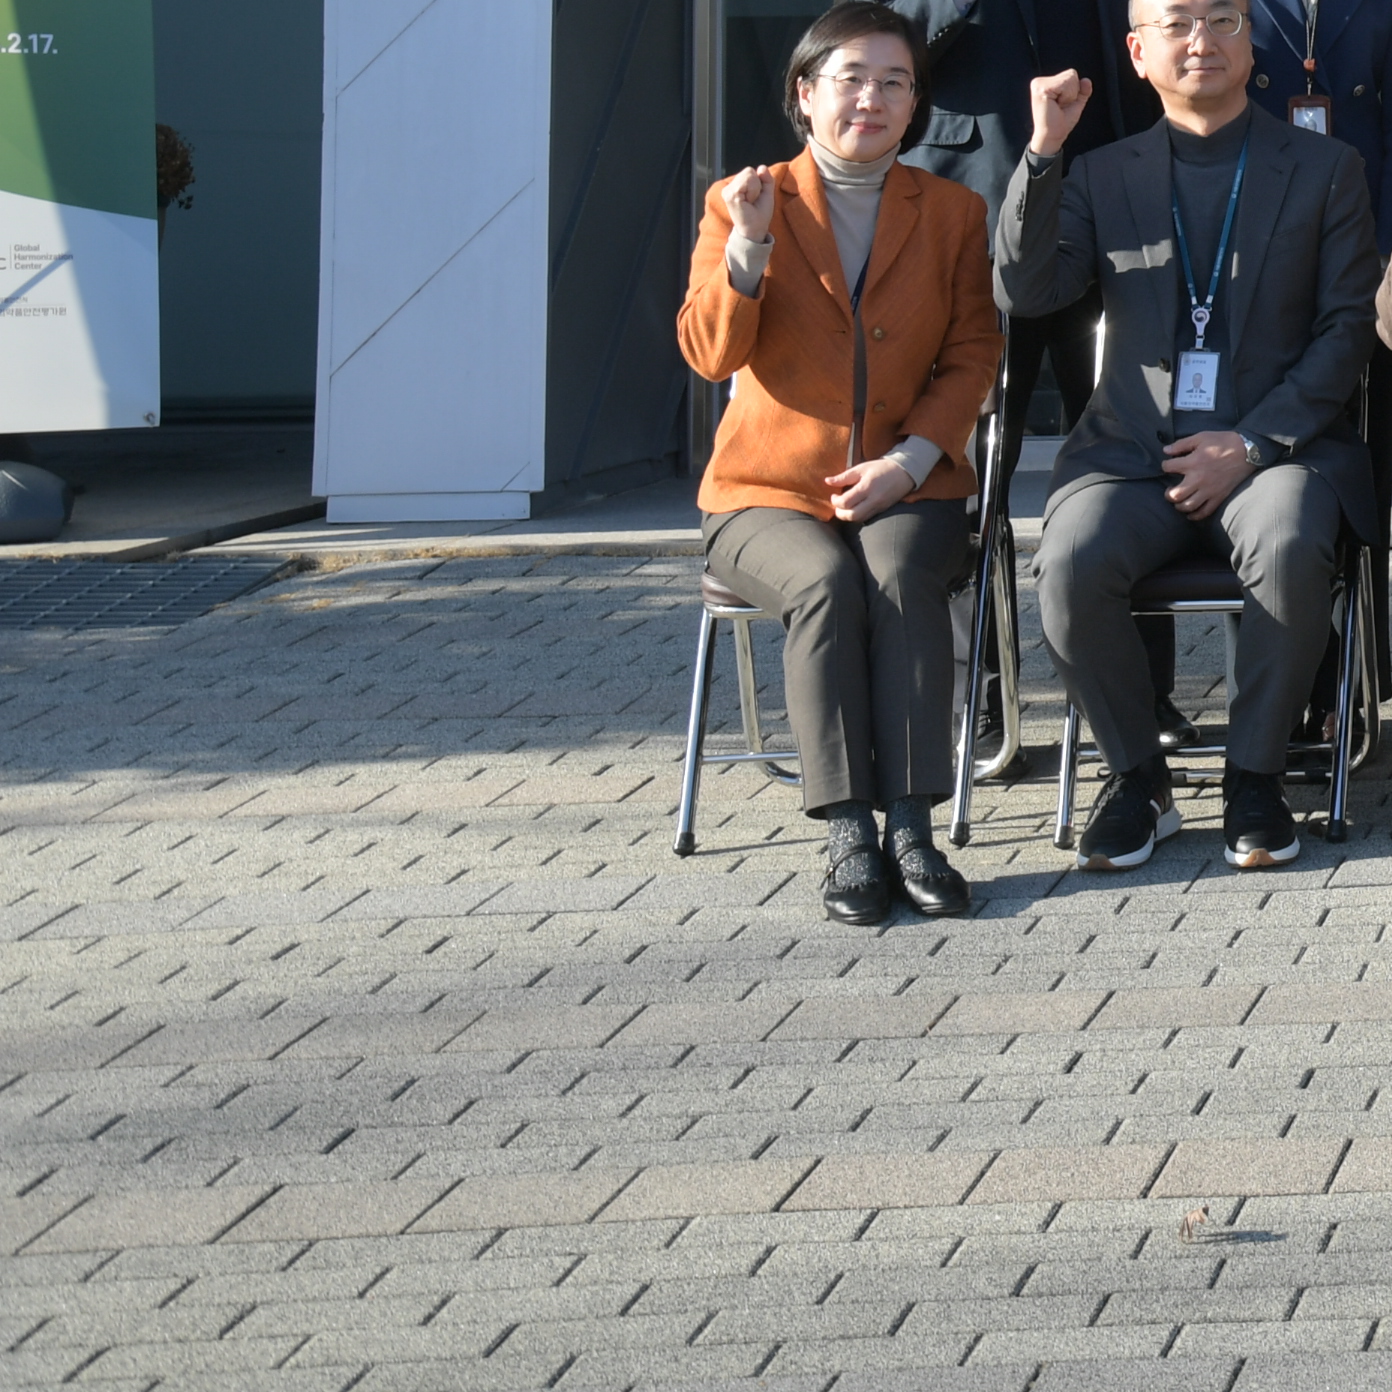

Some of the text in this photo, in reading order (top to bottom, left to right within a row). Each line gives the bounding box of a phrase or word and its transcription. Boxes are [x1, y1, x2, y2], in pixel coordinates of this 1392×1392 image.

[13, 244, 40, 252] Global
[13, 253, 74, 261] Harmonization
[14, 262, 42, 270] Center
